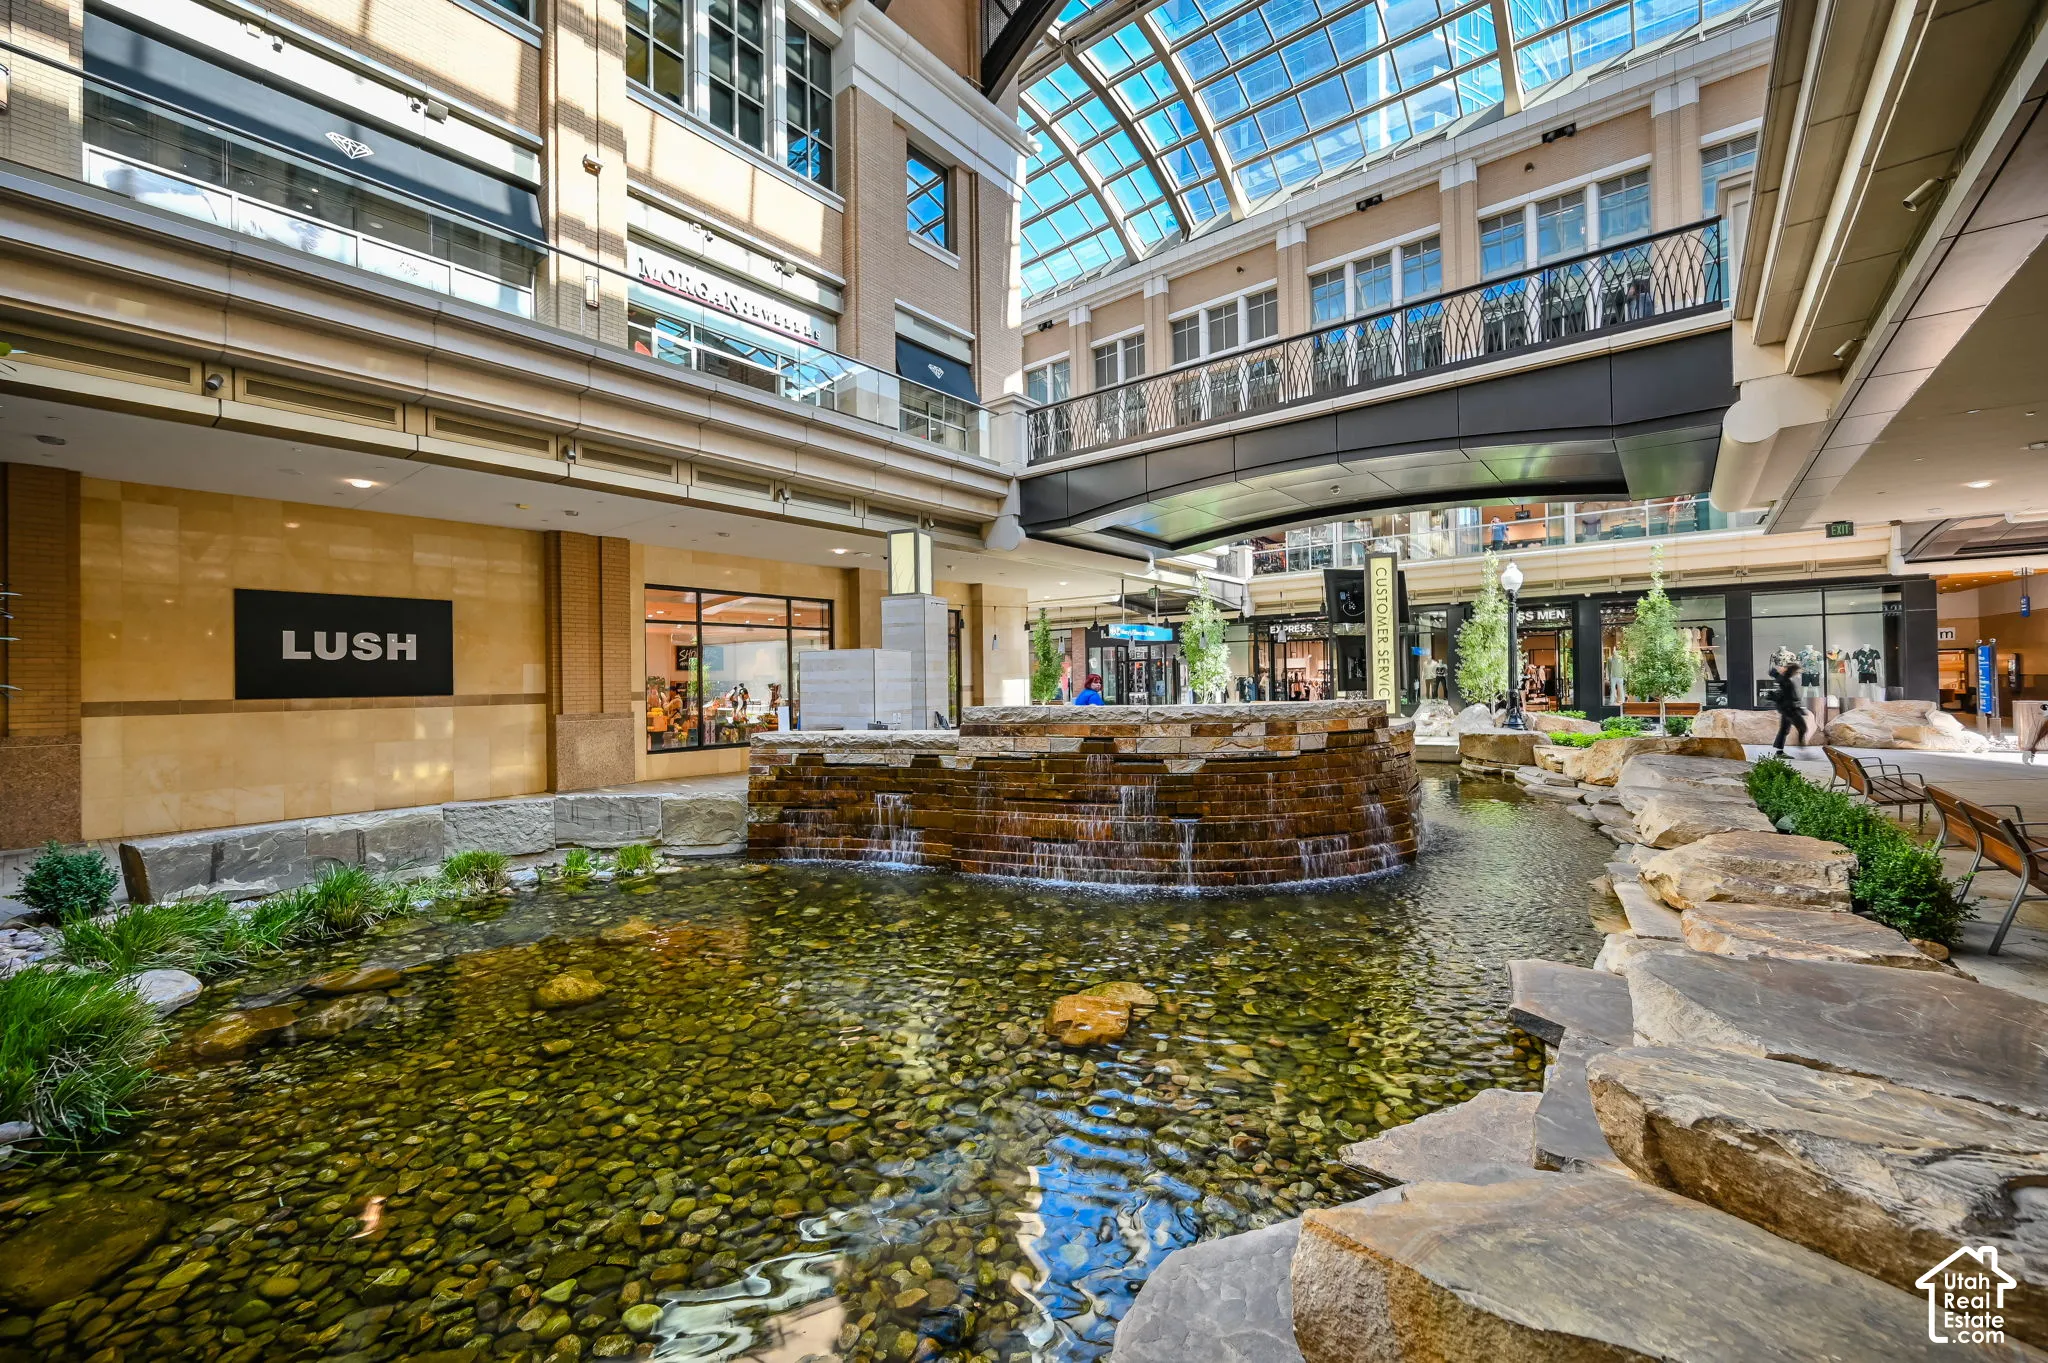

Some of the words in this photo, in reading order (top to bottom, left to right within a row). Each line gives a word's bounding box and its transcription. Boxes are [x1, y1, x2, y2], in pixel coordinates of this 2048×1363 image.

[638, 256, 739, 313] MORGAN
[1831, 524, 1849, 536] EXIT
[1375, 567, 1389, 644] CUSTOMER
[1537, 609, 1566, 620] MEN
[1270, 623, 1313, 634] EXPRESS
[282, 630, 417, 661] LUSH
[1377, 651, 1391, 703] SERVIC
